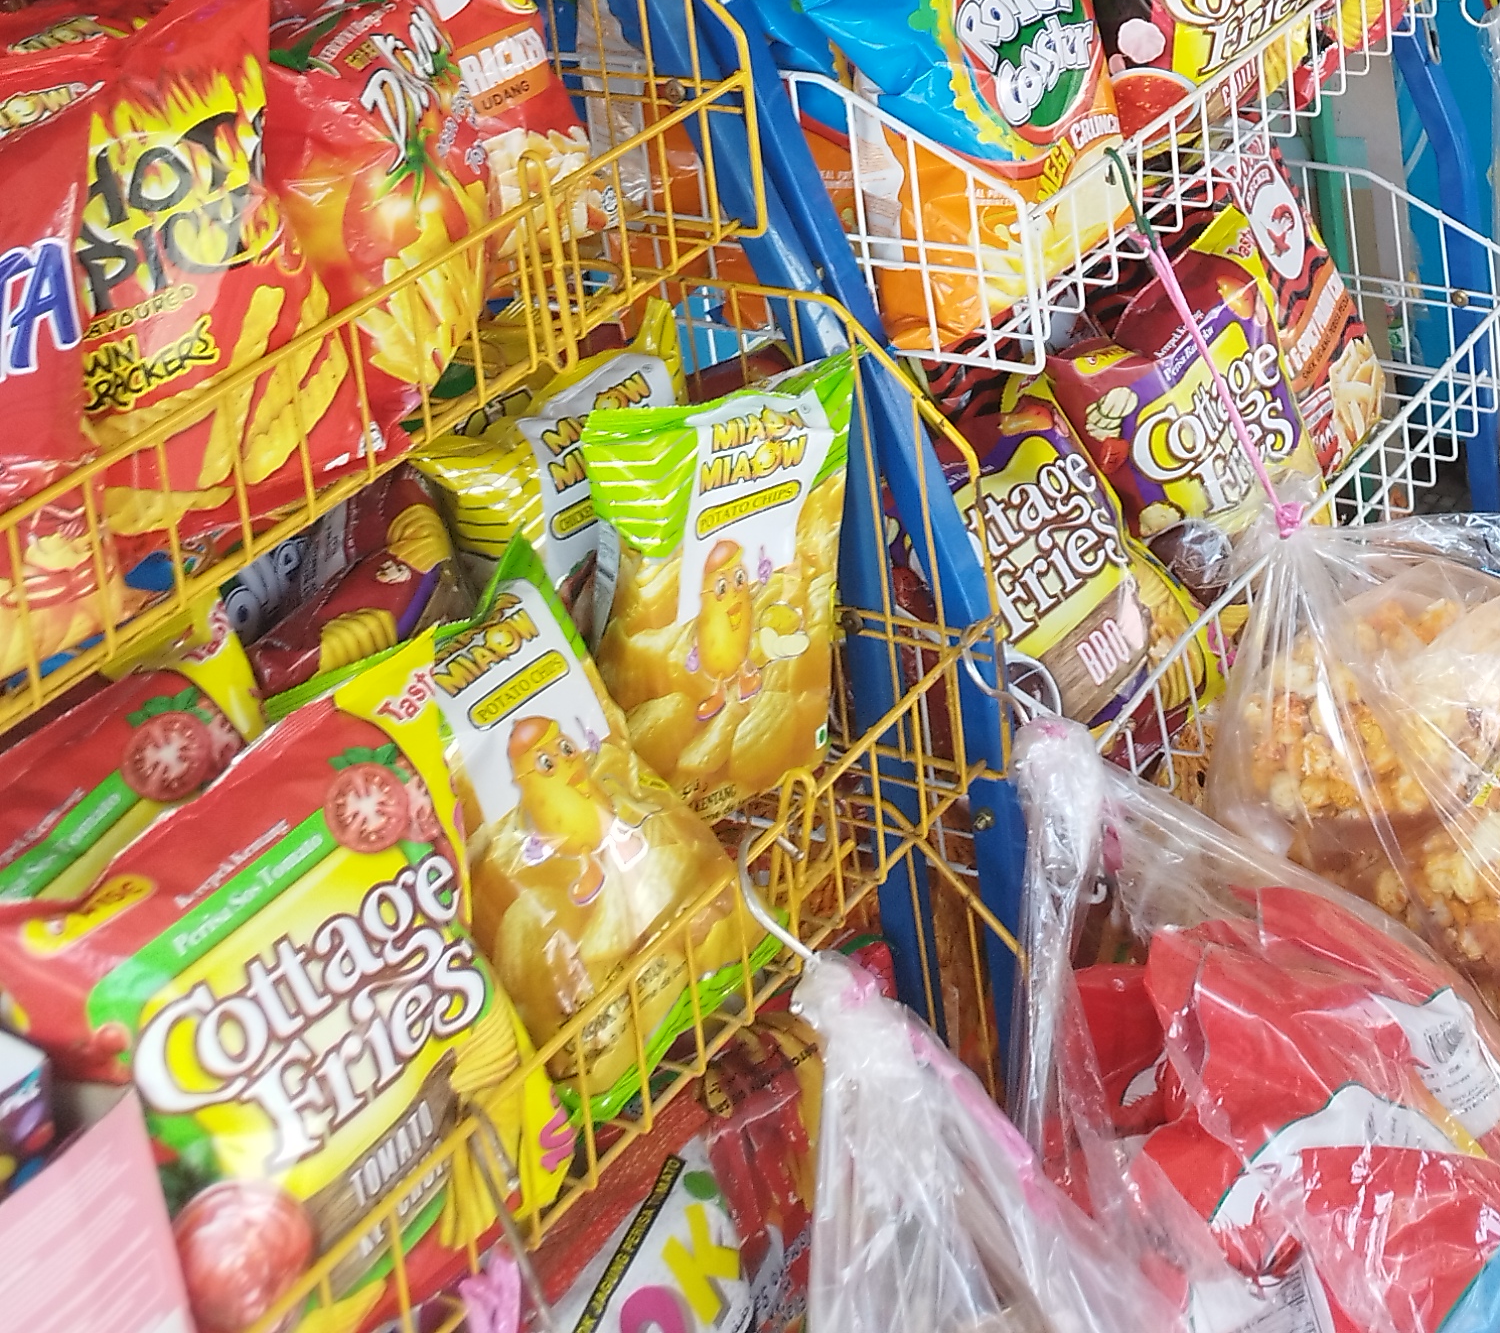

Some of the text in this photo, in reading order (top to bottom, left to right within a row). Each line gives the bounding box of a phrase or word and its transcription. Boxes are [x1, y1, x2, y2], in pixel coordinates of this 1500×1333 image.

[480, 79, 531, 111] UDANG
[998, 17, 1095, 128] Coaster
[1036, 137, 1074, 203] MEGA
[86, 314, 220, 412] RACKERS
[700, 435, 808, 497] MIAOW
[700, 485, 794, 532] POTATO CHIPS
[431, 608, 542, 699] MIAOW
[477, 657, 566, 722] POTATO CHIPS
[132, 852, 461, 1115] Cottage
[235, 938, 486, 1178] Fries
